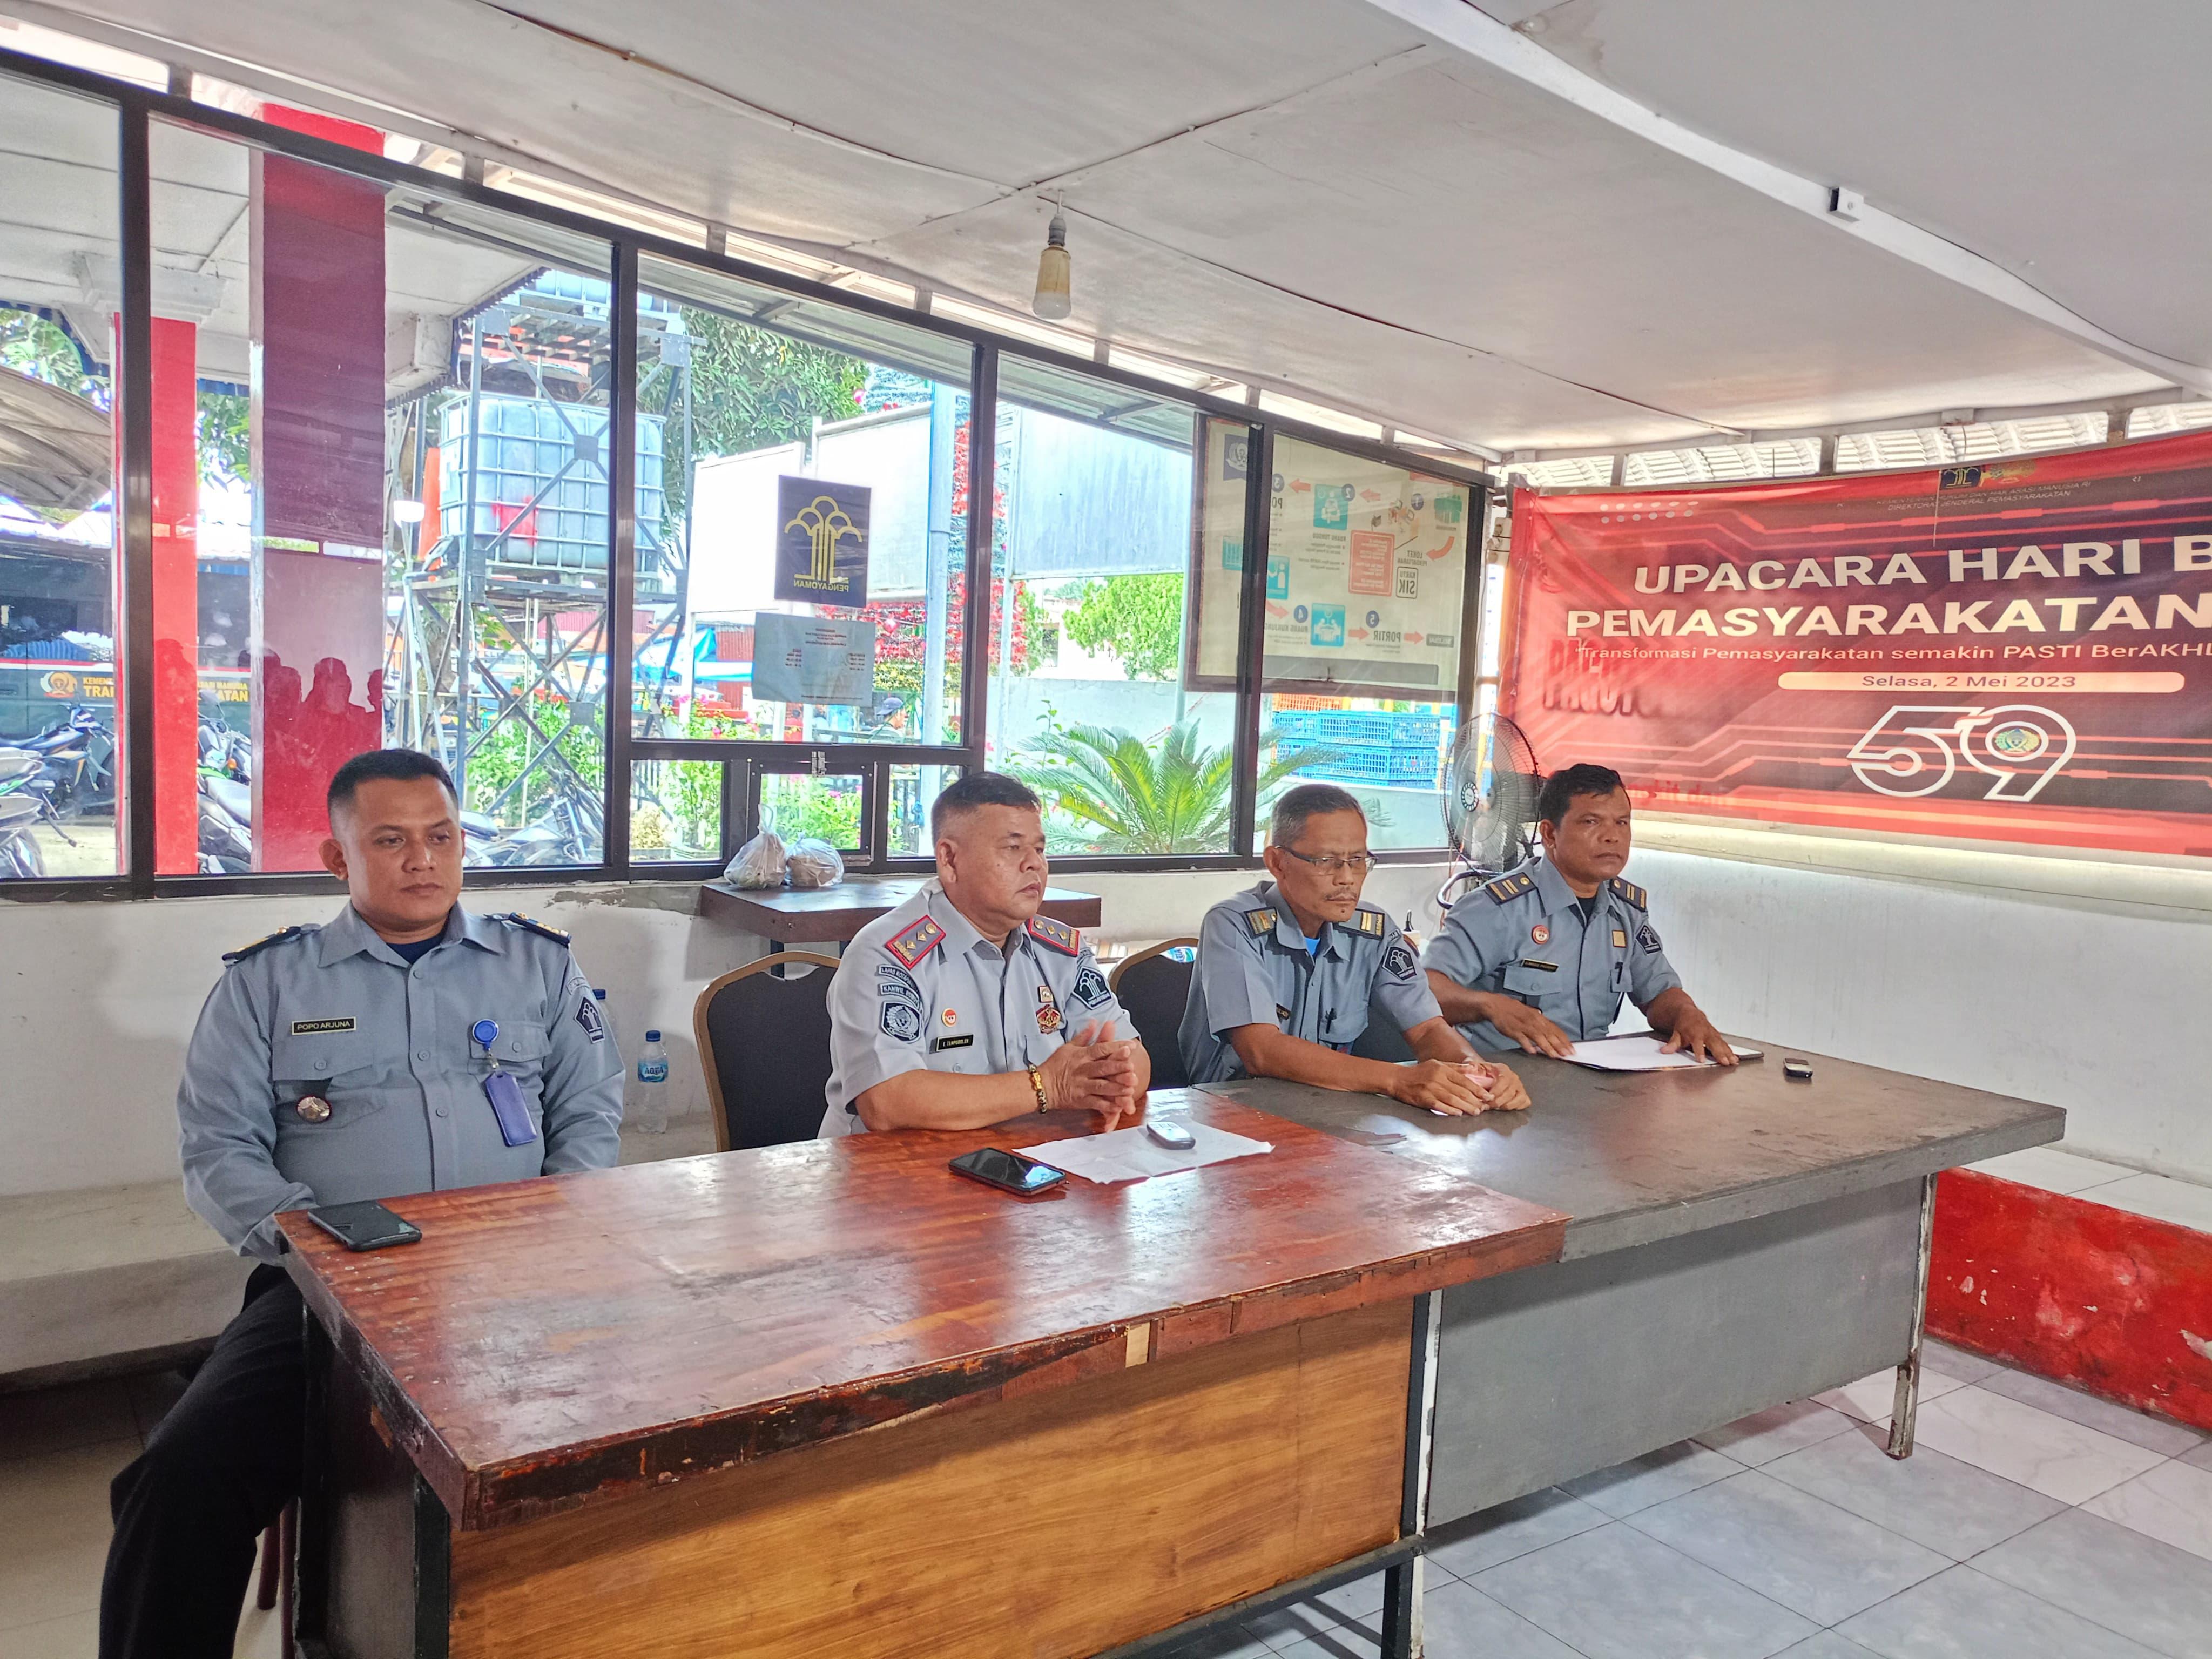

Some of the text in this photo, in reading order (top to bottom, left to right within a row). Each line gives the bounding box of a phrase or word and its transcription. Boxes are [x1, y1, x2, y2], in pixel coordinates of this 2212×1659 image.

[1634, 552, 1927, 594] UPACARA
[1948, 539, 2141, 582] HARI
[1567, 592, 2211, 637] PEMASYARAKATAN
[1702, 646, 1884, 662] Pemasyarakatan
[1891, 646, 1994, 660] semakin
[2003, 644, 2081, 659] PASTI
[1862, 675, 2076, 689] Selasa, 2 Mei 2023
[320, 1020, 350, 1029] ARJUNA
